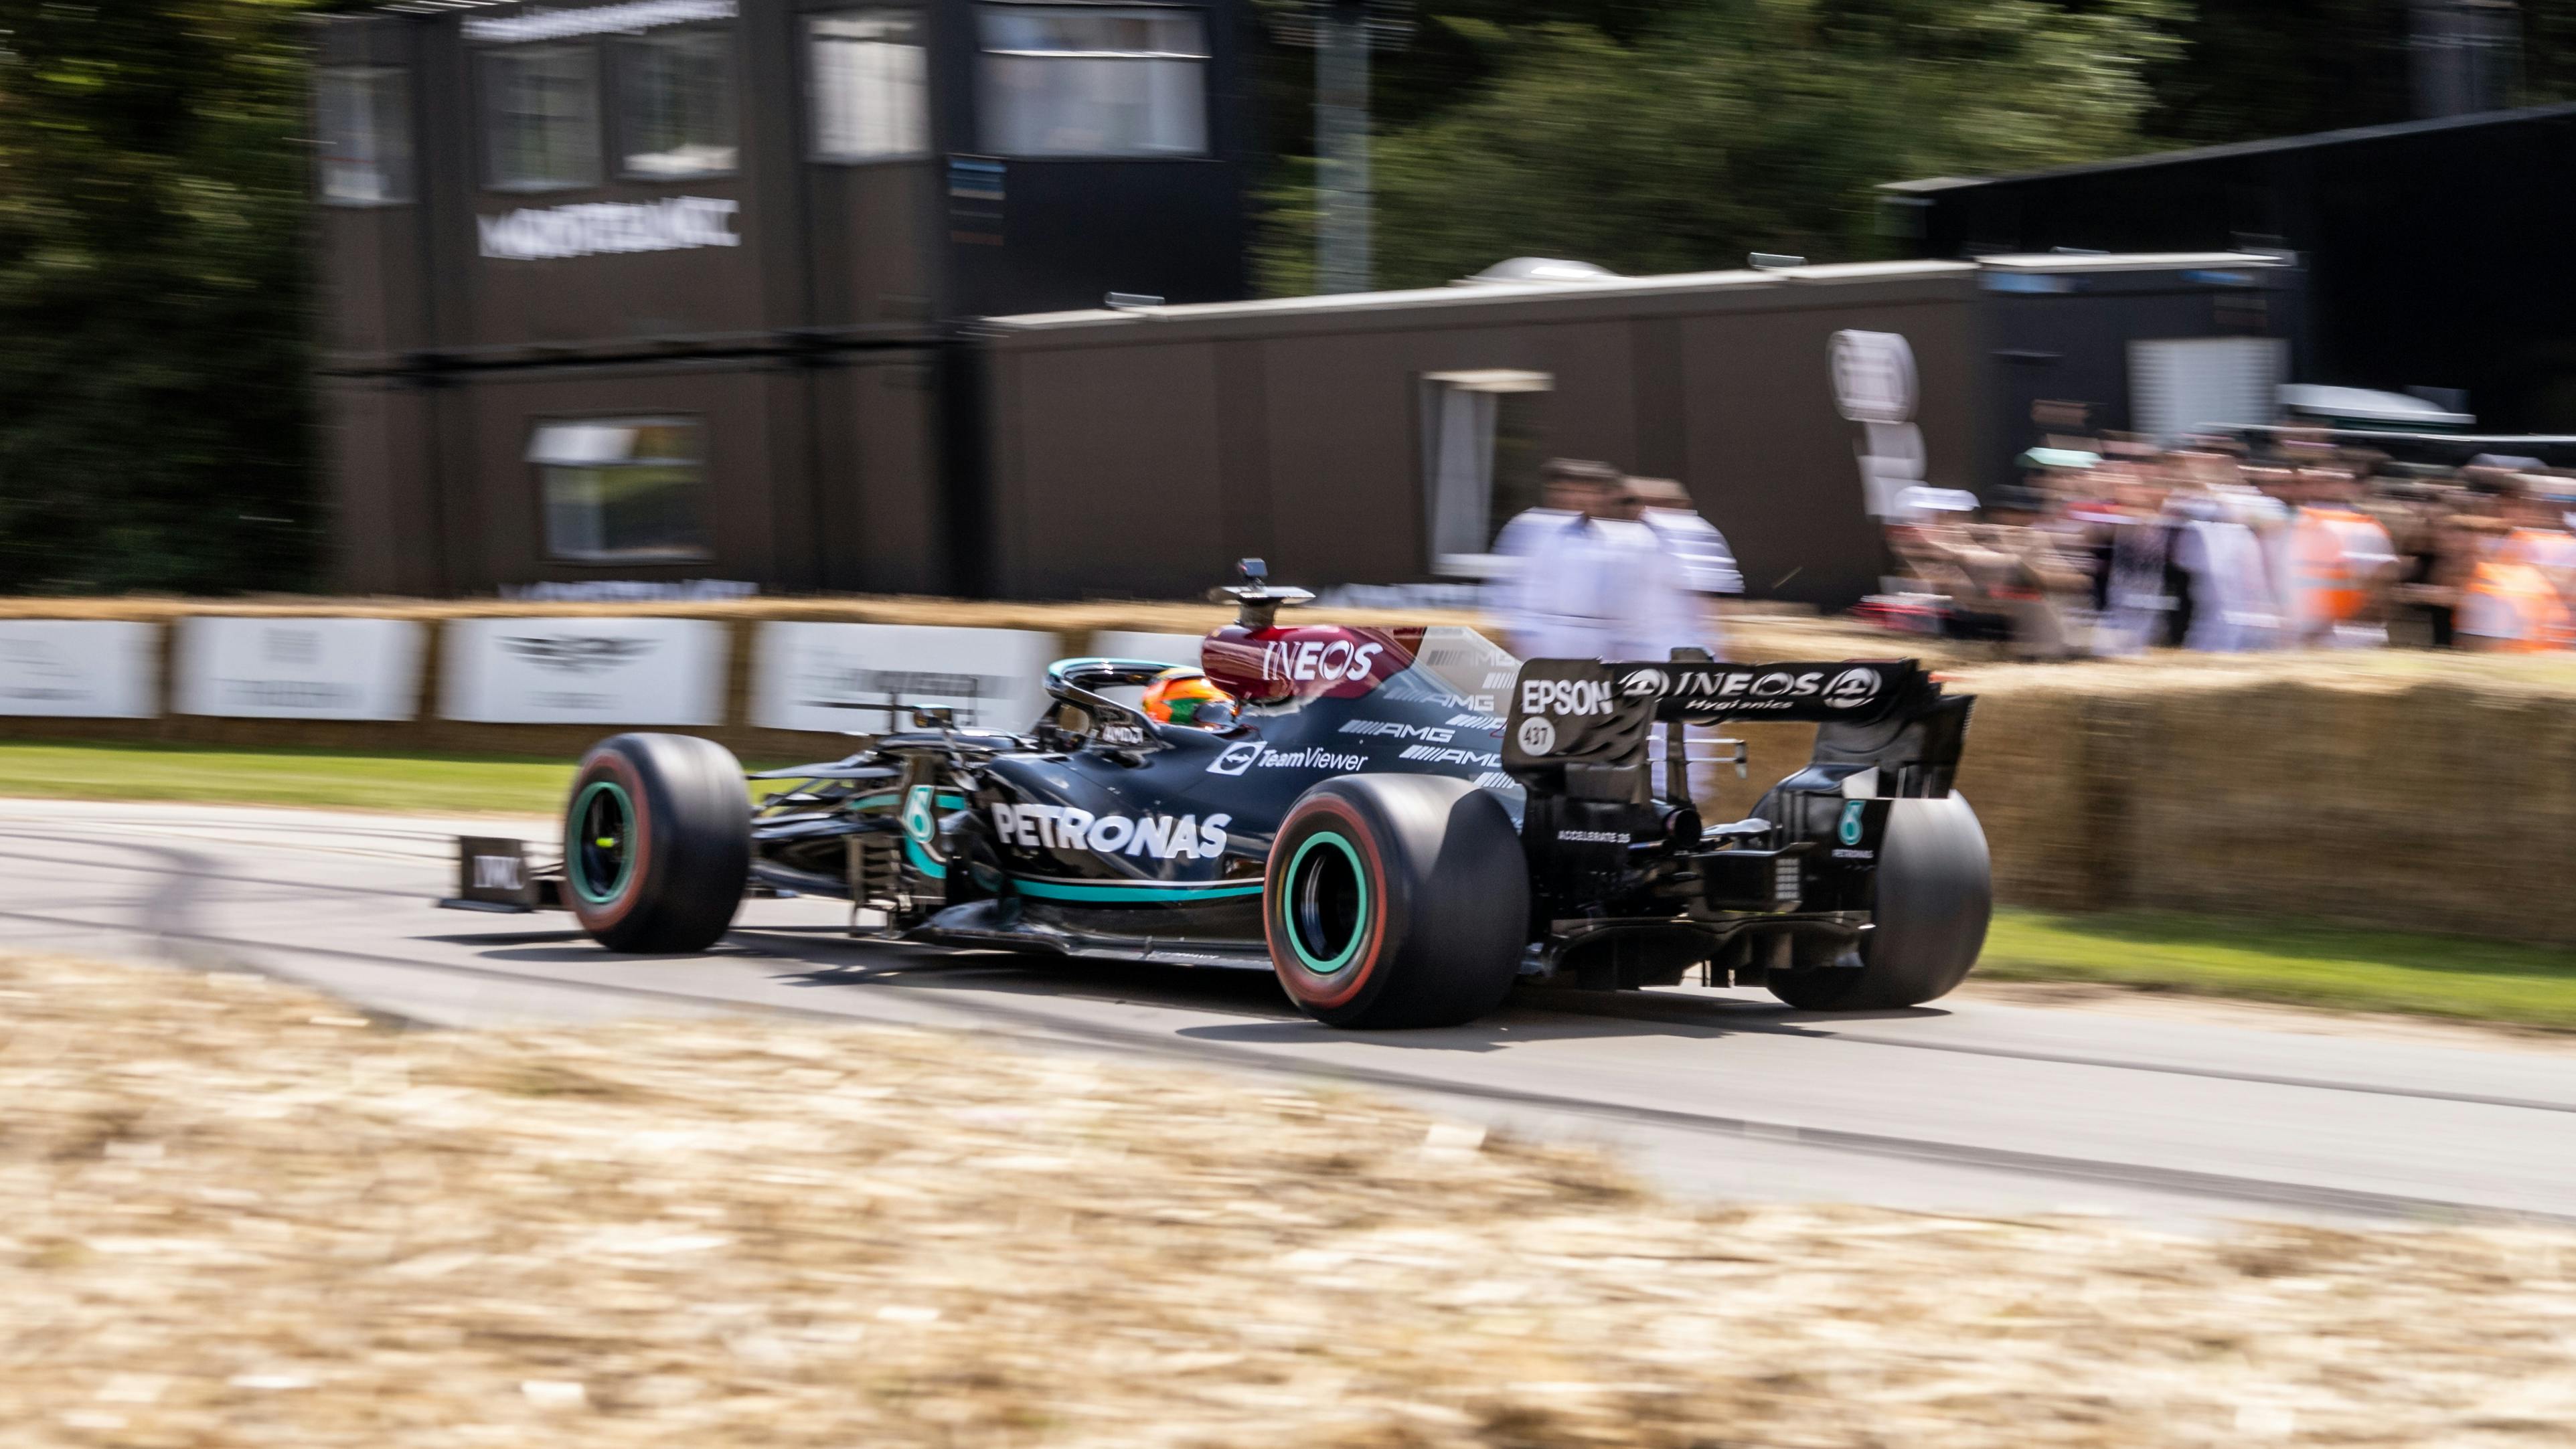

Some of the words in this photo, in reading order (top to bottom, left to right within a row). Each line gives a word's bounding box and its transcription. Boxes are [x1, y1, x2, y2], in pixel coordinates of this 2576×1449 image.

[1261, 641, 1384, 681] INEOS
[1675, 671, 1825, 696] INEOS
[1421, 693, 1495, 711] AMG
[1522, 679, 1614, 715] EPSON
[1373, 721, 1456, 743] AMG
[1524, 727, 1550, 746] 437
[1257, 748, 1369, 772] TeamViewer
[991, 802, 1232, 859] PETRONAS
